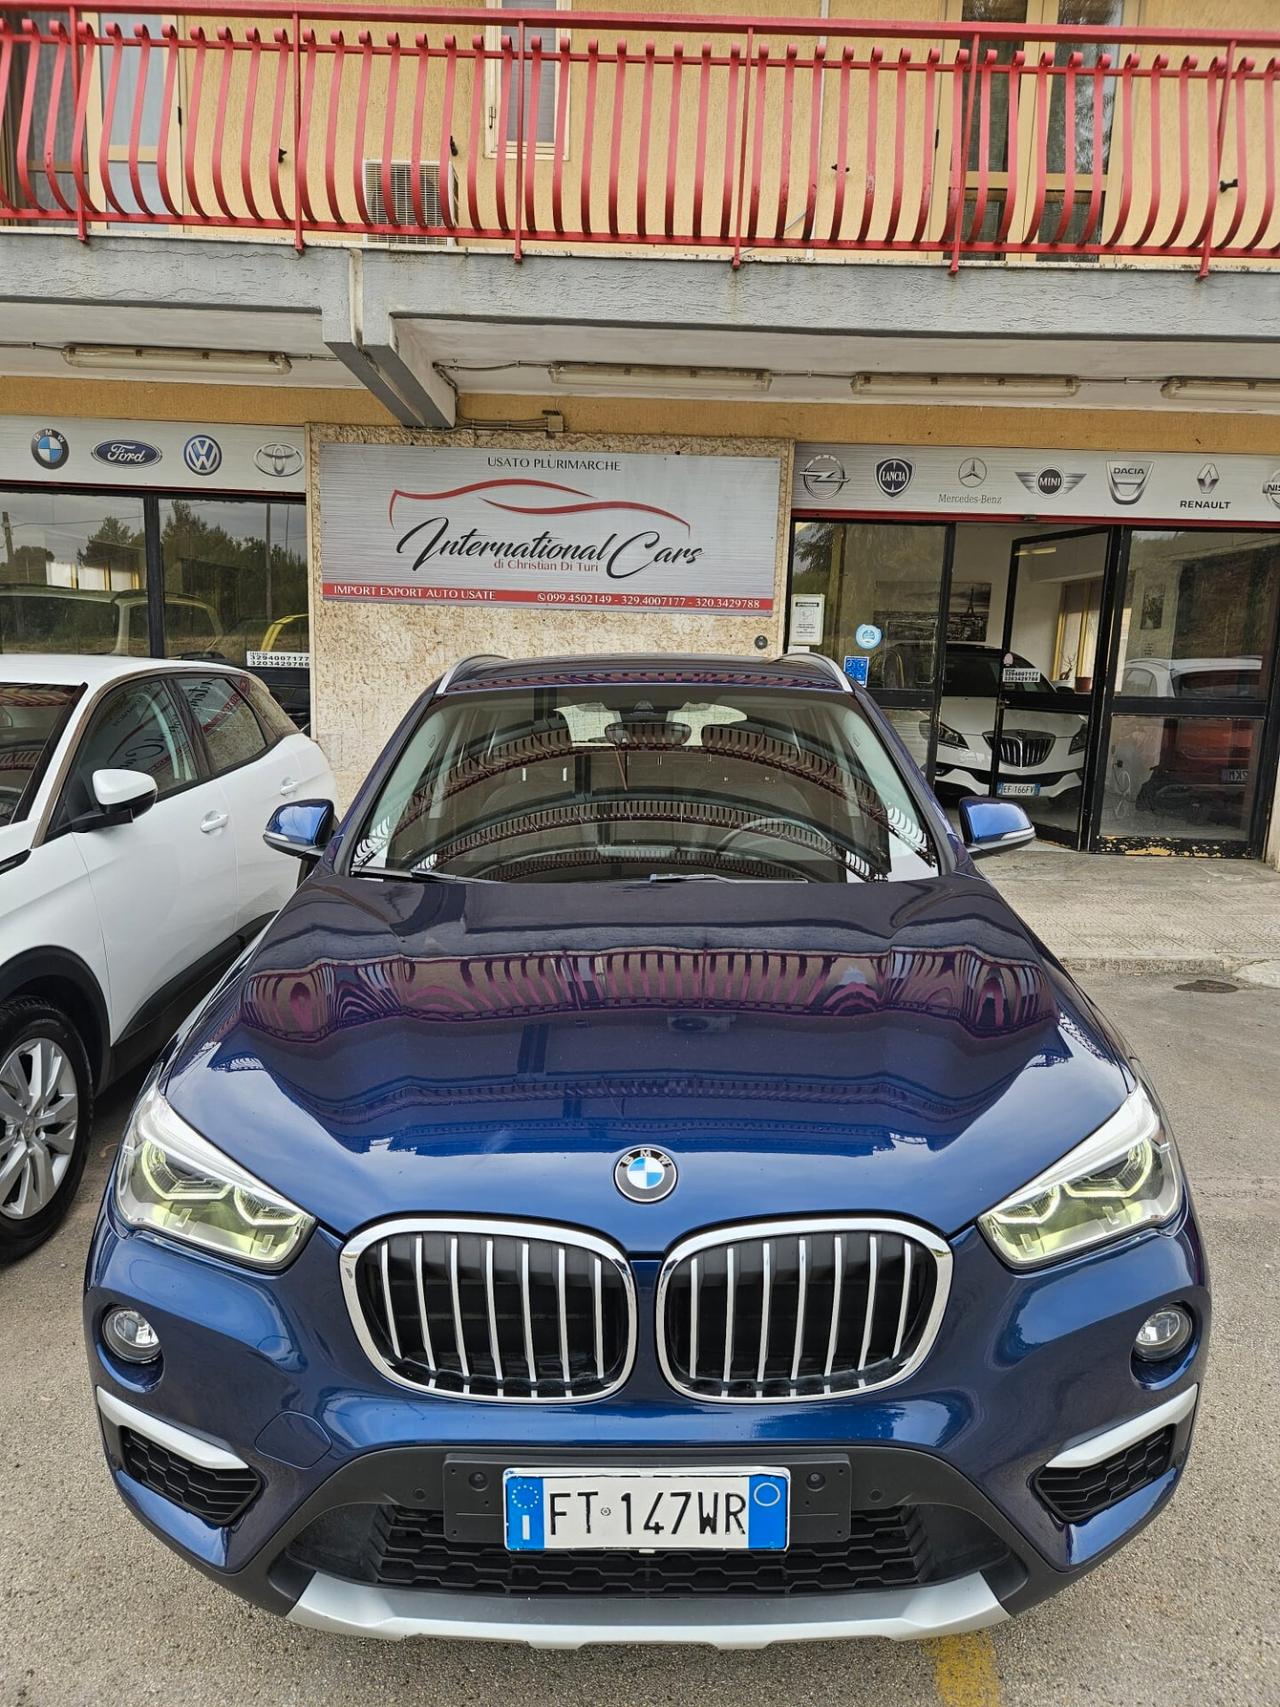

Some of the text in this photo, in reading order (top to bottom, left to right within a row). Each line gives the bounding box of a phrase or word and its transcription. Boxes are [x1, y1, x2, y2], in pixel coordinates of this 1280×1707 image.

[107, 444, 145, 463] Ford
[487, 457, 622, 472] USATO PLURIMARCHE
[1113, 467, 1145, 475] DACIA
[881, 470, 906, 482] LANCIA
[1038, 477, 1062, 488] MINI
[938, 493, 1002, 504] Mercedes-Benz
[1179, 500, 1231, 510] RENAULT
[396, 517, 705, 579] International Cars
[493, 559, 599, 572] di Christian Di Turi
[333, 585, 377, 596] IMPORT
[380, 587, 424, 597] EXPORT
[426, 589, 459, 599] AUTO
[461, 590, 496, 600] USATE
[547, 593, 612, 604] 099.4502149
[621, 597, 686, 607] 329.4007177
[695, 599, 760, 609] 320.3429788
[621, 1150, 671, 1166] BMW
[549, 1491, 599, 1535] FT
[620, 1491, 747, 1535] 147WR
